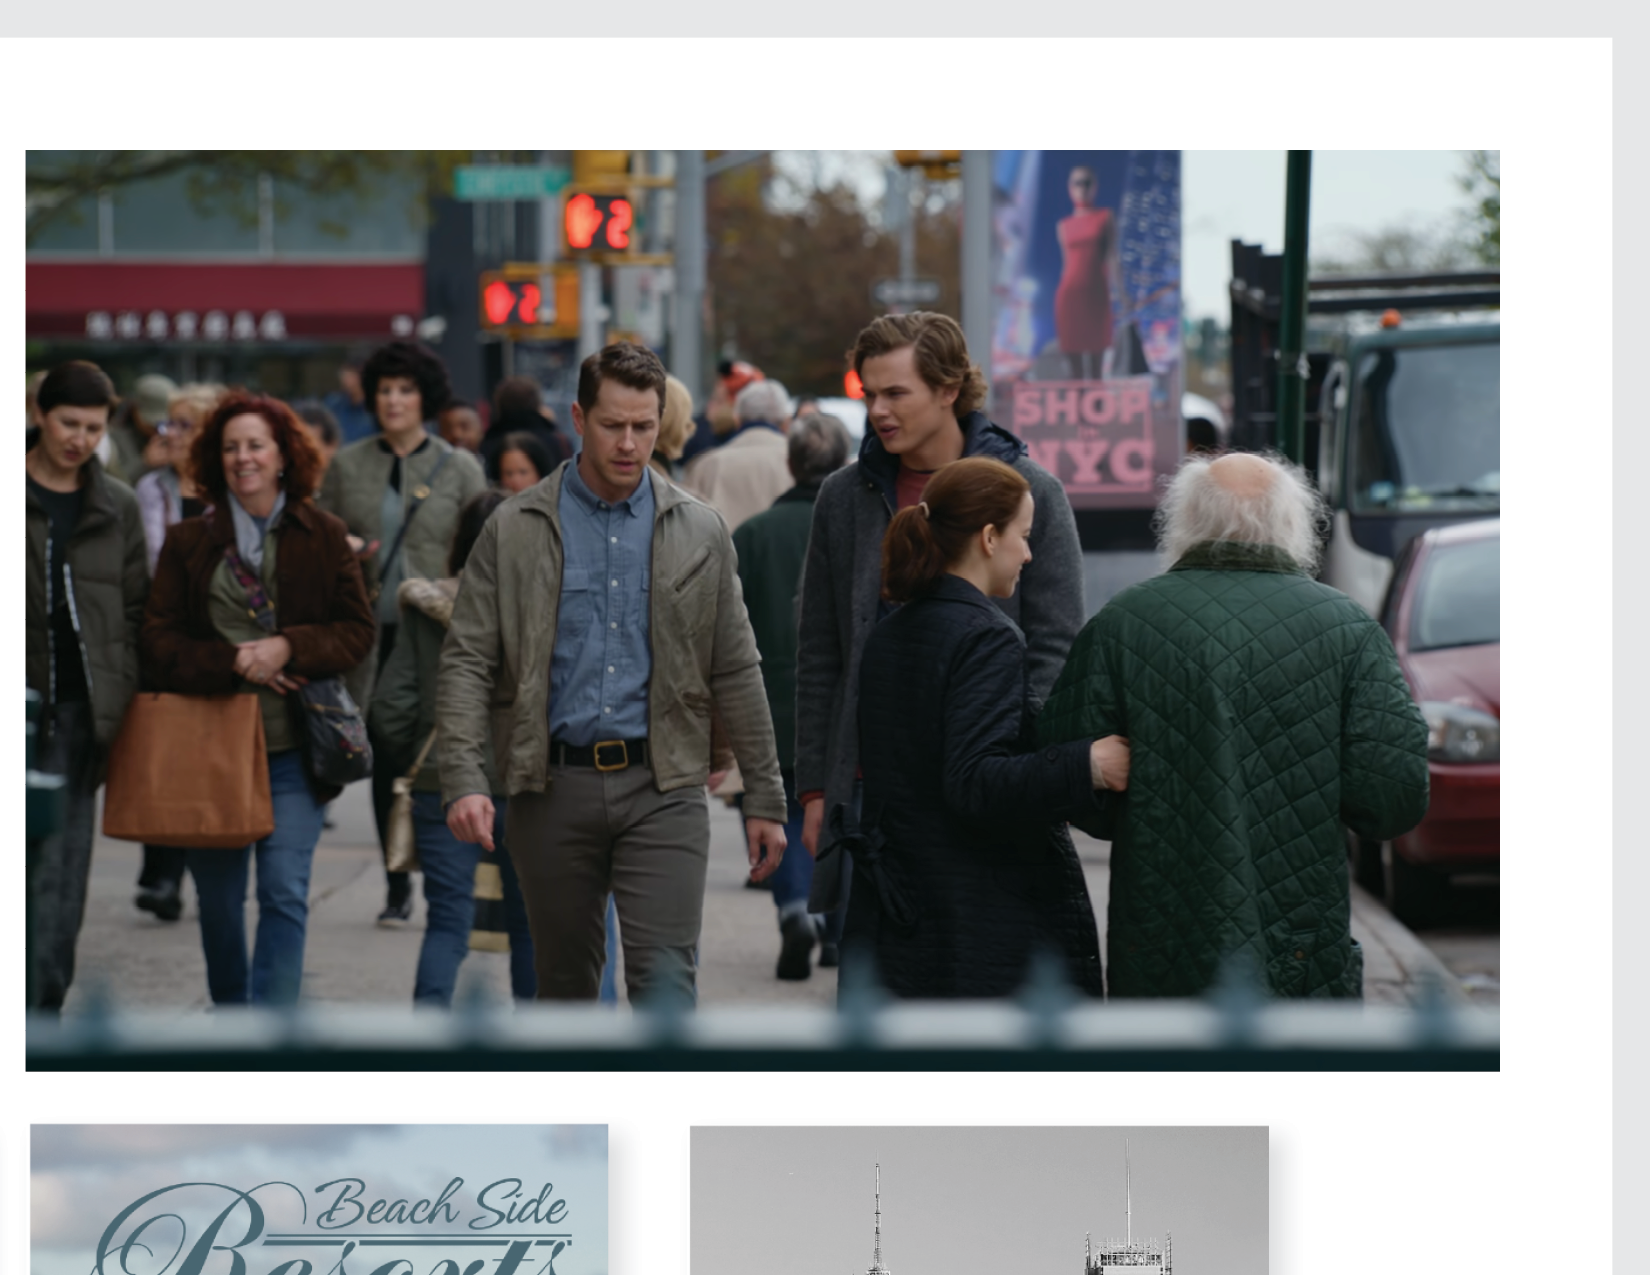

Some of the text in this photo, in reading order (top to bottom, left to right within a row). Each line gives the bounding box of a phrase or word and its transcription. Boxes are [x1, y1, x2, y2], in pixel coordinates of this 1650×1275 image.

[606, 199, 633, 249] 2
[1015, 387, 1149, 426] SHOP
[1028, 438, 1156, 484] NYC
[315, 1177, 569, 1230] Beach Side
